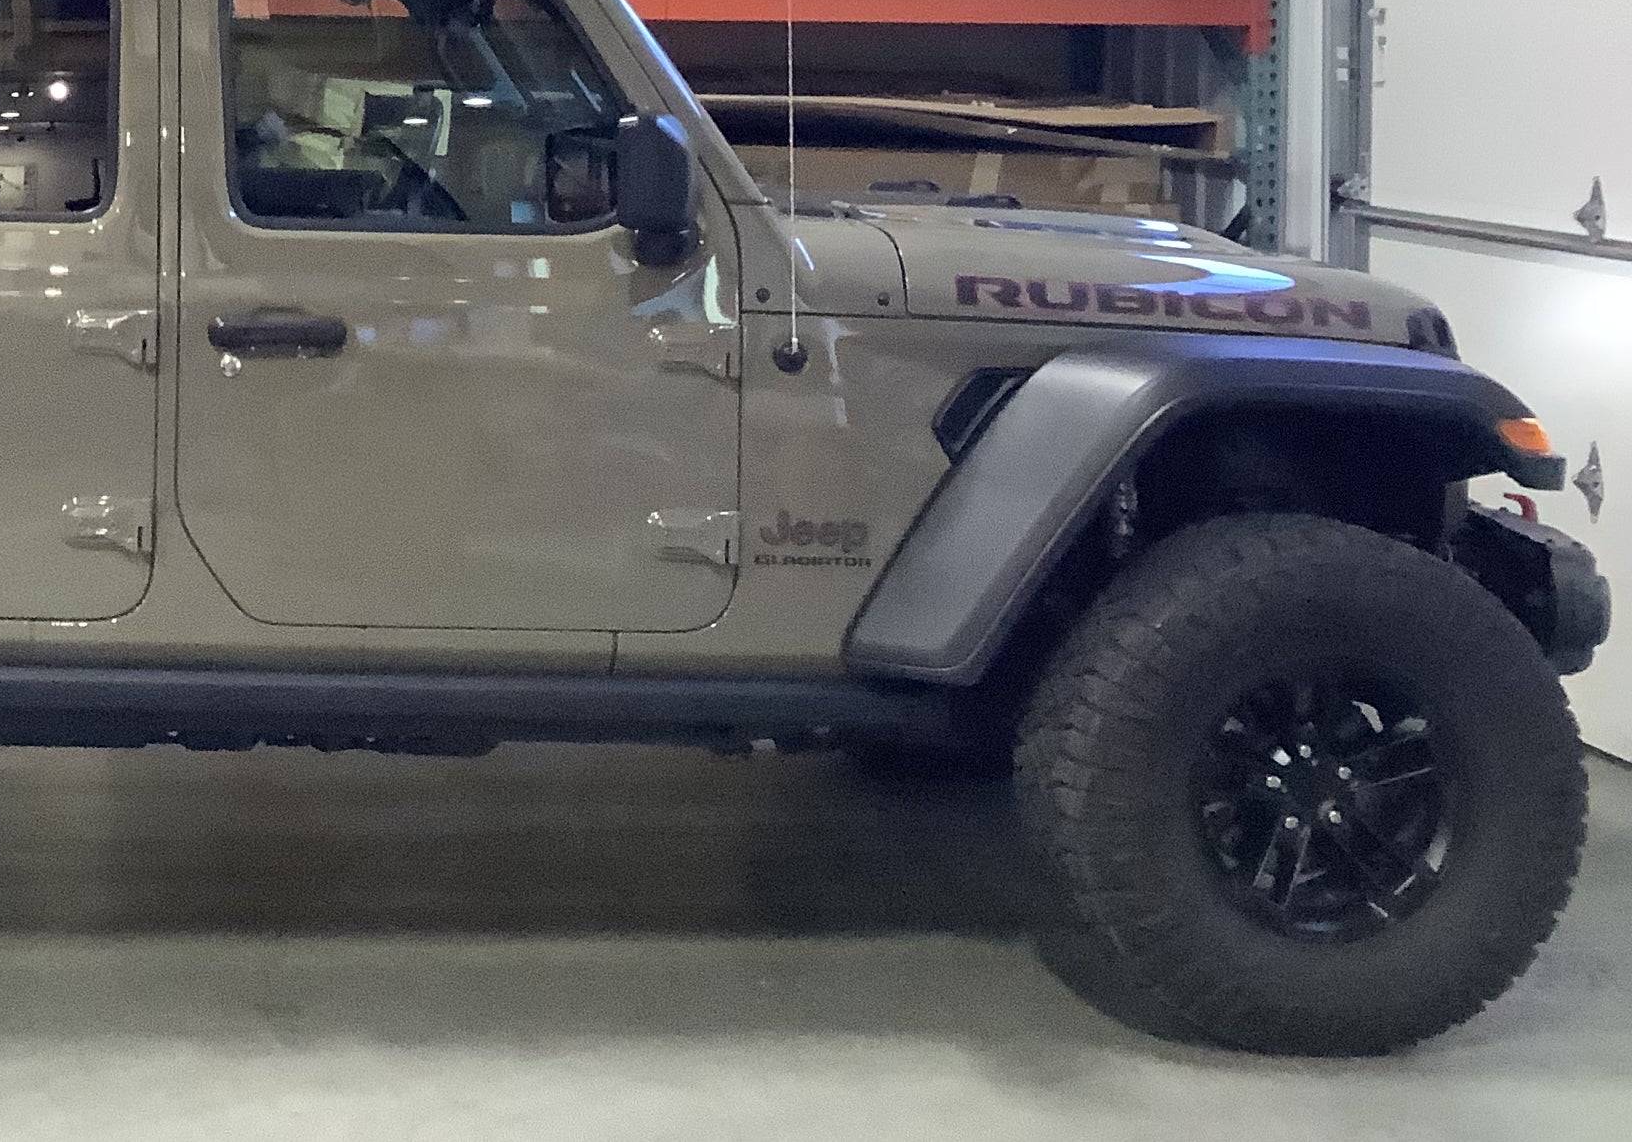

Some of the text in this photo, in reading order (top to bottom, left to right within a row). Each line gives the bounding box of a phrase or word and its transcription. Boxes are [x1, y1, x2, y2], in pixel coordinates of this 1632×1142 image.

[955, 274, 1372, 330] RUBICON
[759, 508, 868, 554] Jeep
[753, 554, 873, 569] GLADIATOR
